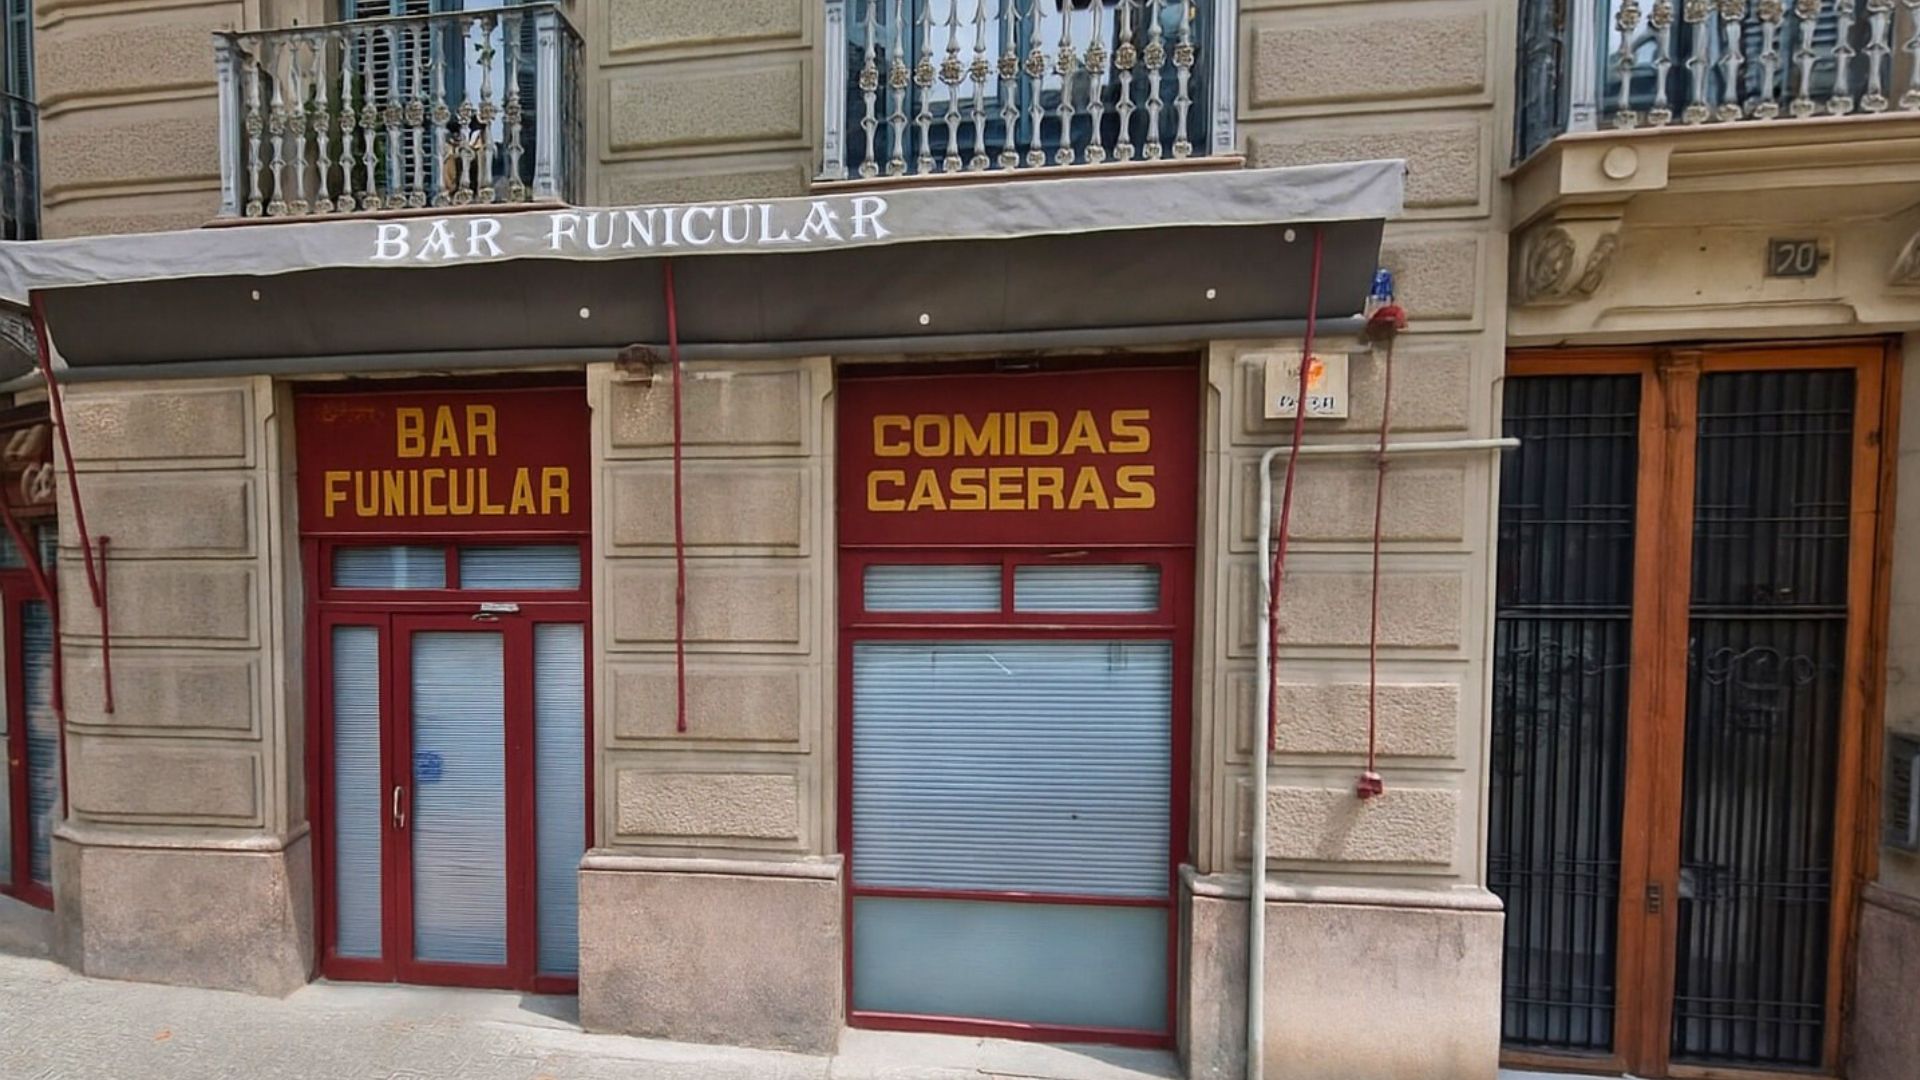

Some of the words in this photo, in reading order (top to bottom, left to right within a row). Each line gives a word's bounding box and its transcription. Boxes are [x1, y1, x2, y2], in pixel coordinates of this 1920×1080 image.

[370, 218, 504, 260] BAR
[543, 196, 891, 250] FUNICULAR
[396, 404, 497, 458] BAR
[873, 409, 1151, 457] COMIDAS
[324, 466, 570, 518] FUNICULAR
[866, 465, 1156, 511] CASERAS
